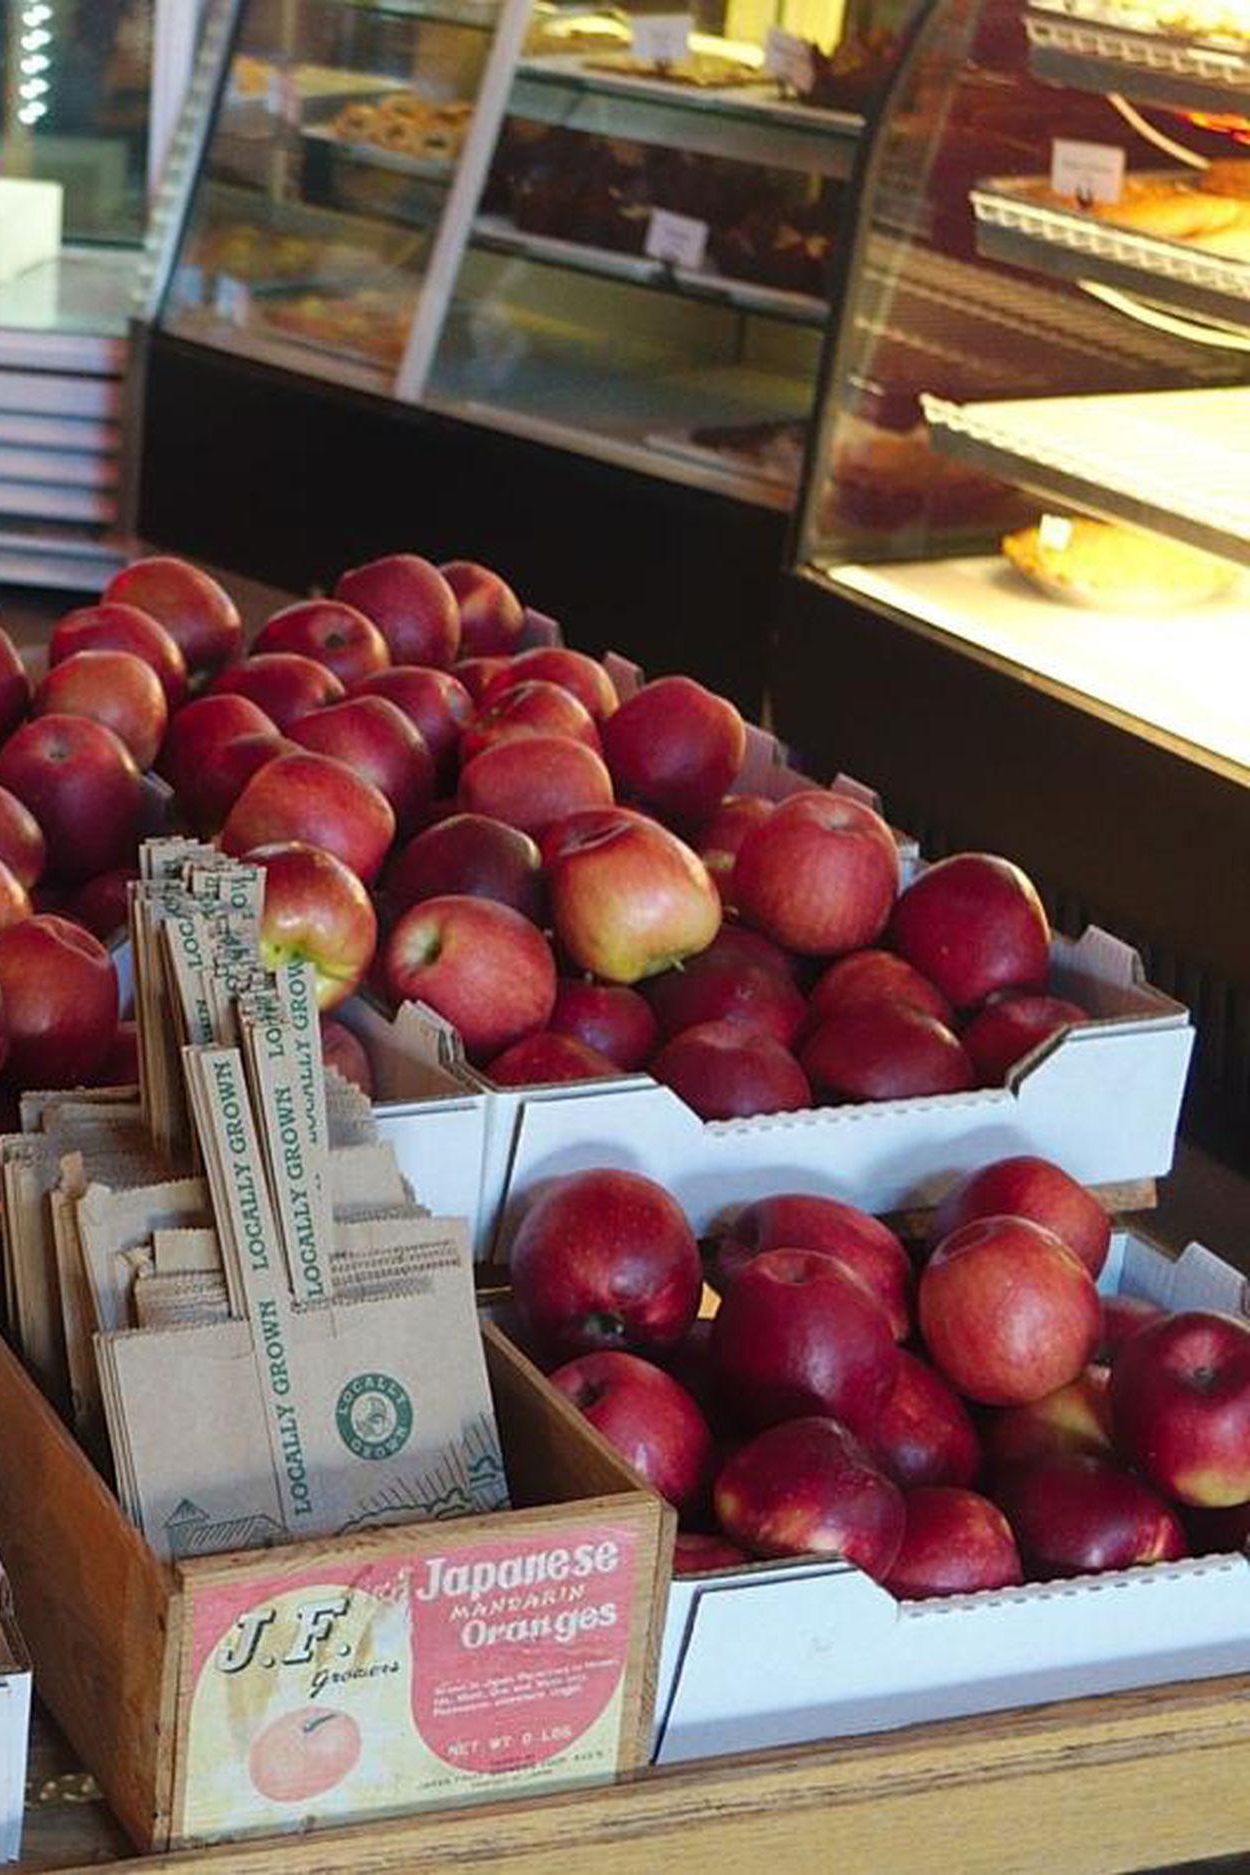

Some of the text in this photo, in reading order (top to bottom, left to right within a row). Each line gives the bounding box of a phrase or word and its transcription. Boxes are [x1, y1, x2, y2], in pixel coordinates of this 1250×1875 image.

[214, 1061, 269, 1271] LOCALLY GROWN
[274, 1086, 304, 1180] GROWN
[290, 1188, 324, 1298] LOCALLY
[259, 1300, 313, 1516] LOCALLY GROWN
[415, 1540, 619, 1601] Japanese
[450, 1584, 587, 1622] MANDARIN
[460, 1602, 618, 1650] Oranges
[446, 1738, 480, 1756] NET
[488, 1734, 514, 1750] WT
